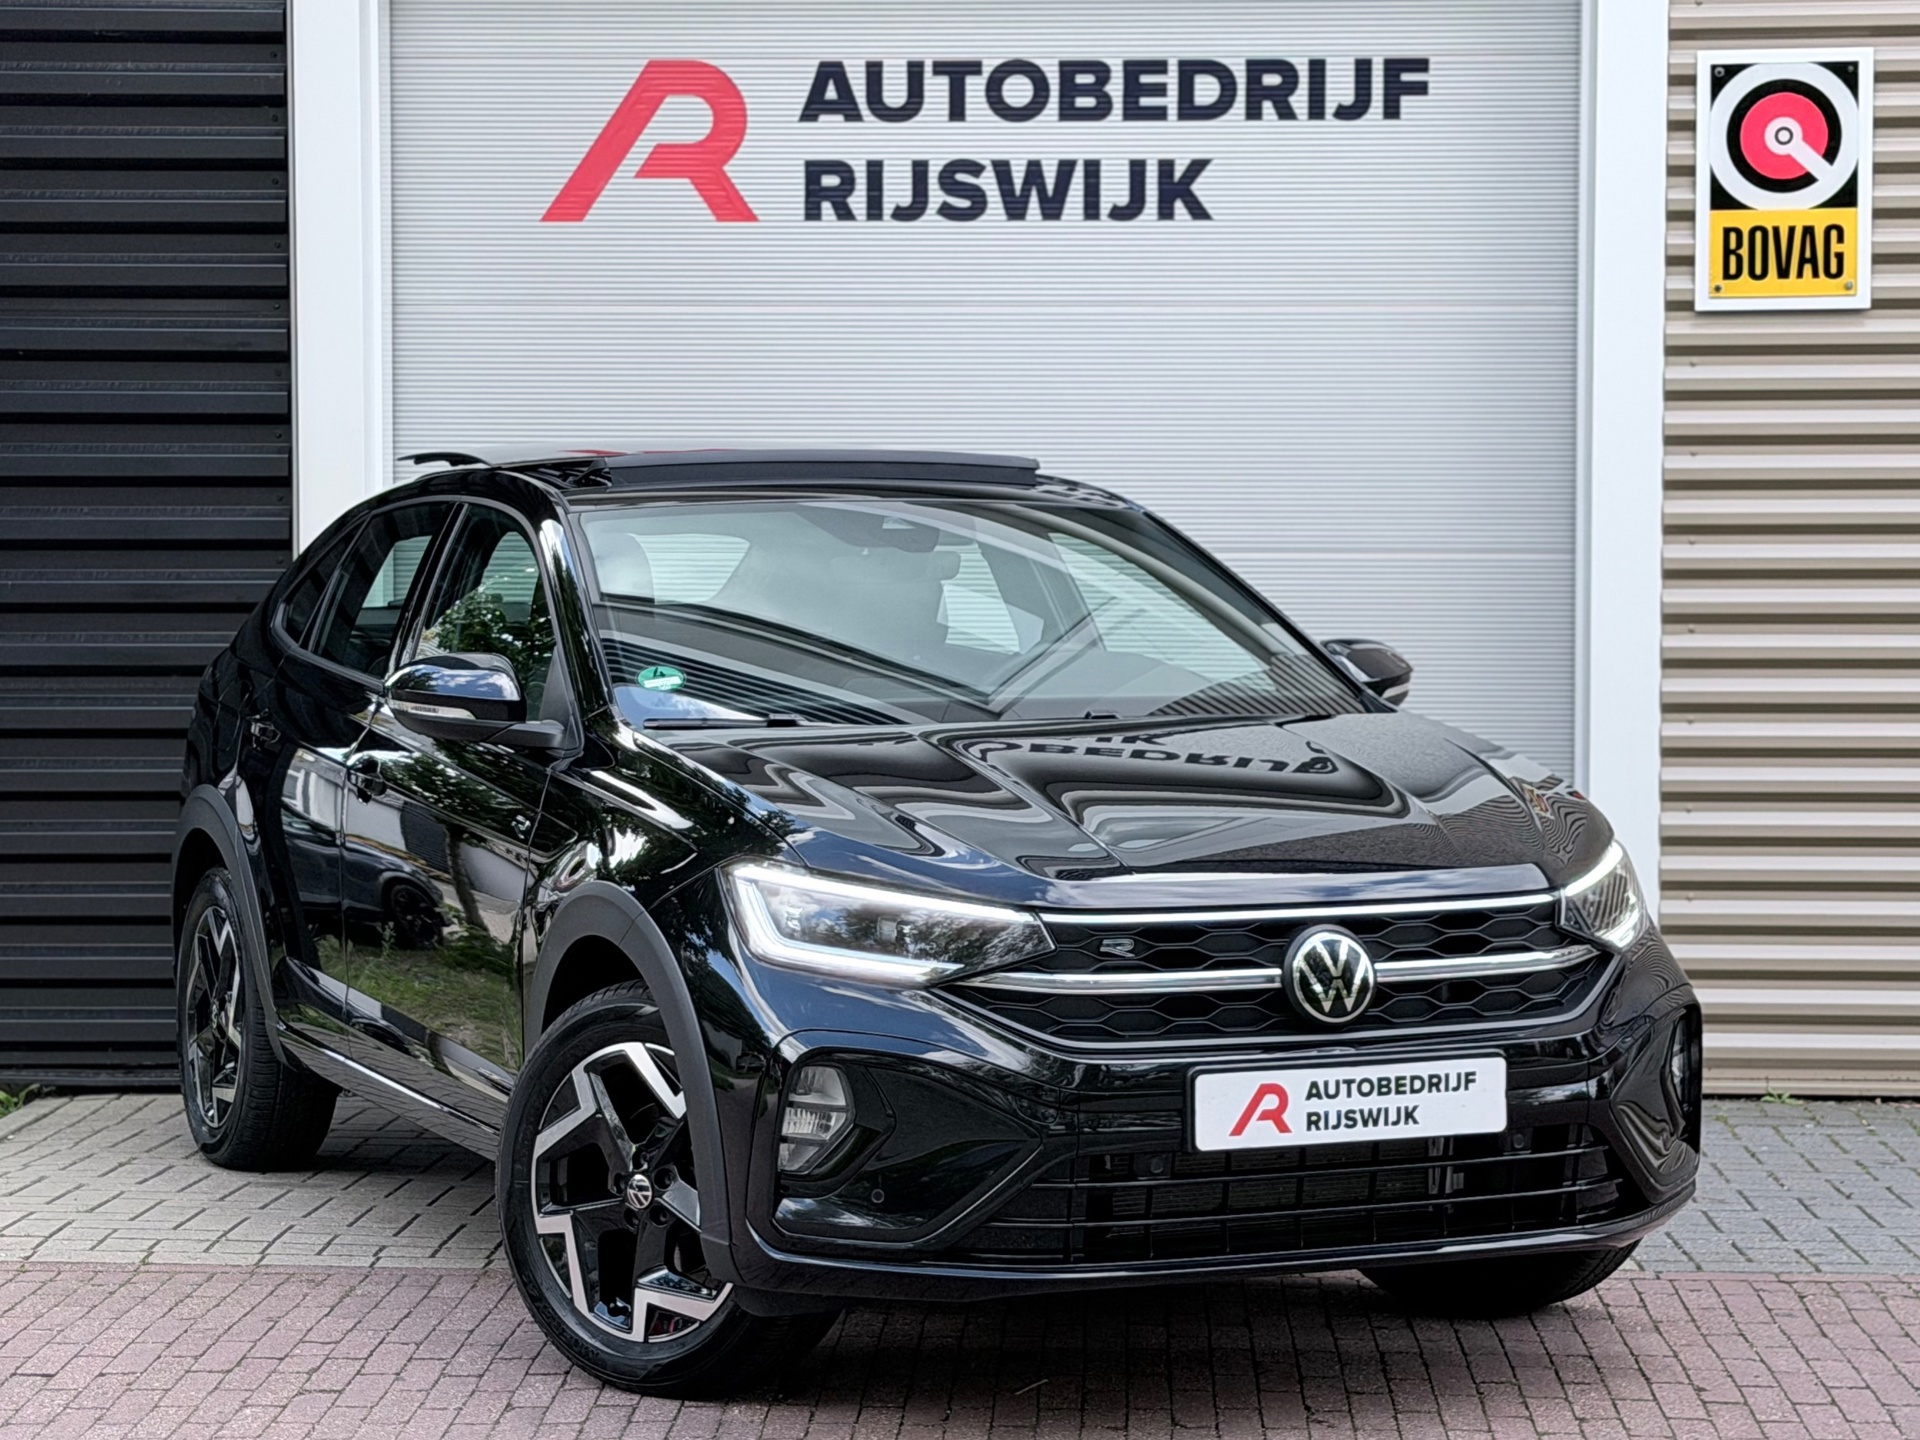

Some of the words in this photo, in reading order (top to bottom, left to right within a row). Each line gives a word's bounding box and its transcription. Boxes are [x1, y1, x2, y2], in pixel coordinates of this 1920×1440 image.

[799, 57, 1430, 123] AUTOBEDRIJF
[803, 158, 1214, 222] RIJSWIJK
[1721, 223, 1846, 281] BOVAG
[1291, 931, 1375, 1023] VW
[1305, 1070, 1477, 1102] AUTOBEDRIJF
[1305, 1104, 1420, 1132] RIJSWIJK
